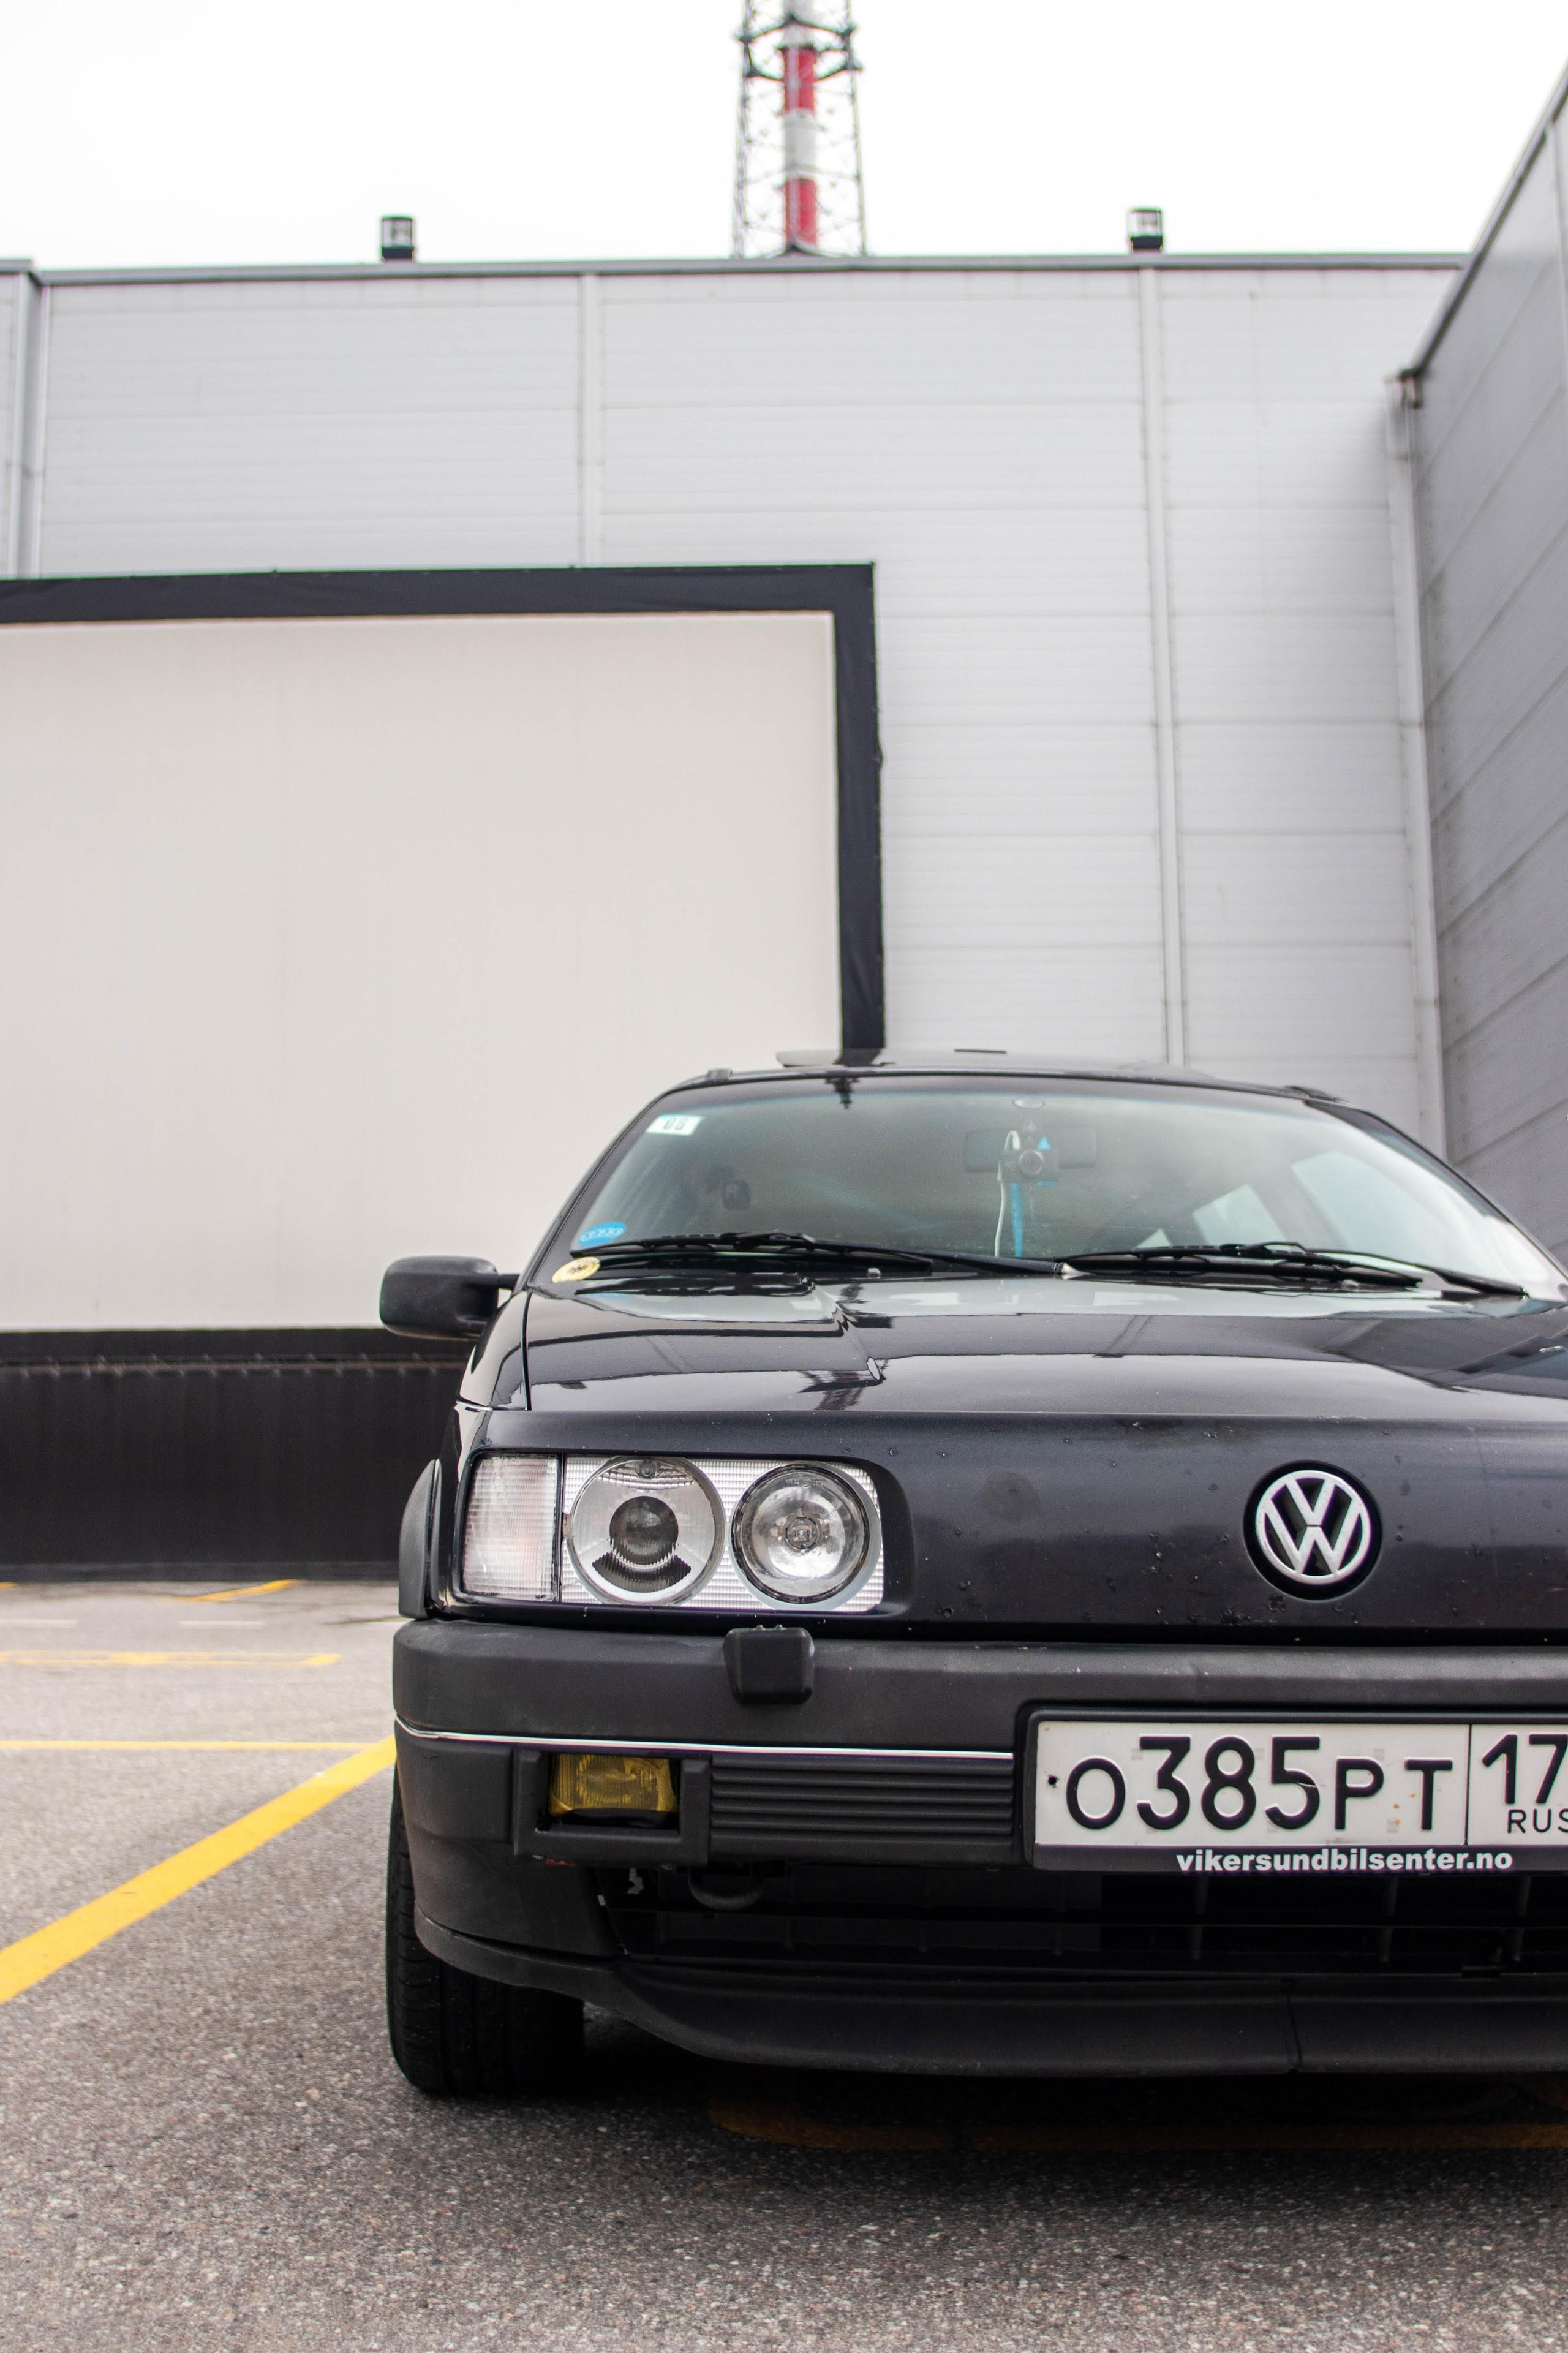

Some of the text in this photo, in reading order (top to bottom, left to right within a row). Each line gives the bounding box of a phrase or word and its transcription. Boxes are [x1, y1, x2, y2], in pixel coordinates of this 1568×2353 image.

[1256, 1470, 1371, 1584] VW
[1482, 1734, 1568, 1805] 17
[1176, 1848, 1513, 1871] vikersundbilsenter.no
